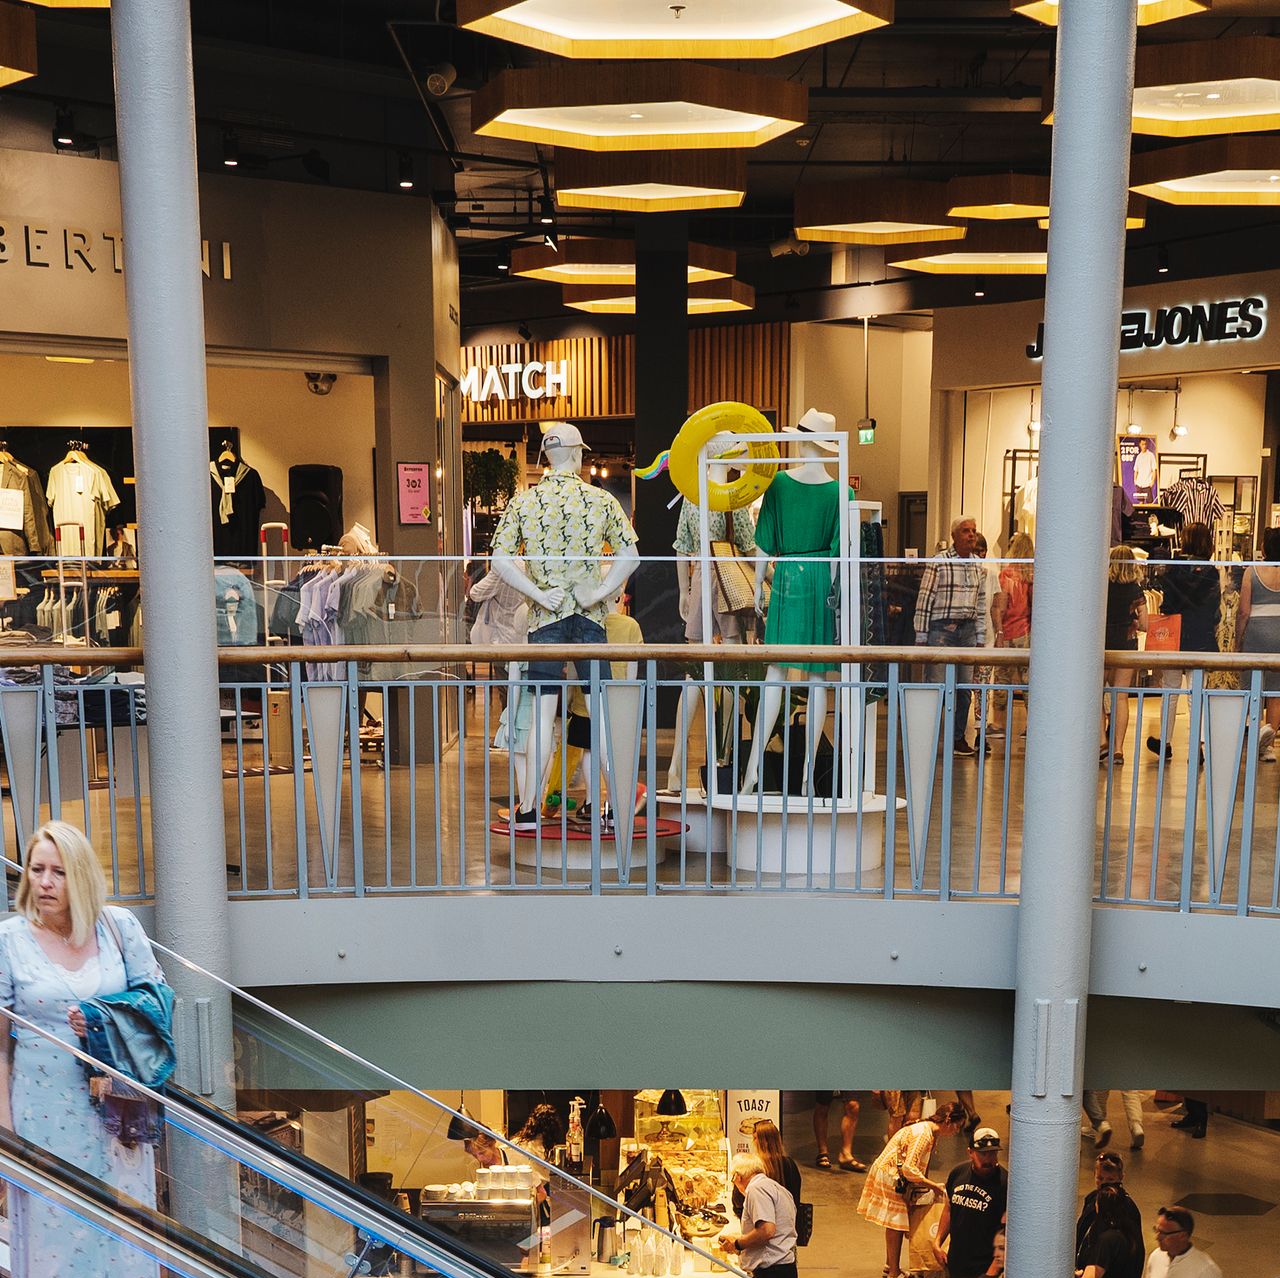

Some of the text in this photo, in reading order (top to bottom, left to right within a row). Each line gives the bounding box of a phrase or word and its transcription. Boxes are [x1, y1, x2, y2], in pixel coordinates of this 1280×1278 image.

[460, 359, 570, 402] MATCH
[737, 1099, 771, 1112] TOAST
[951, 1194, 989, 1212] BOKASSA?
